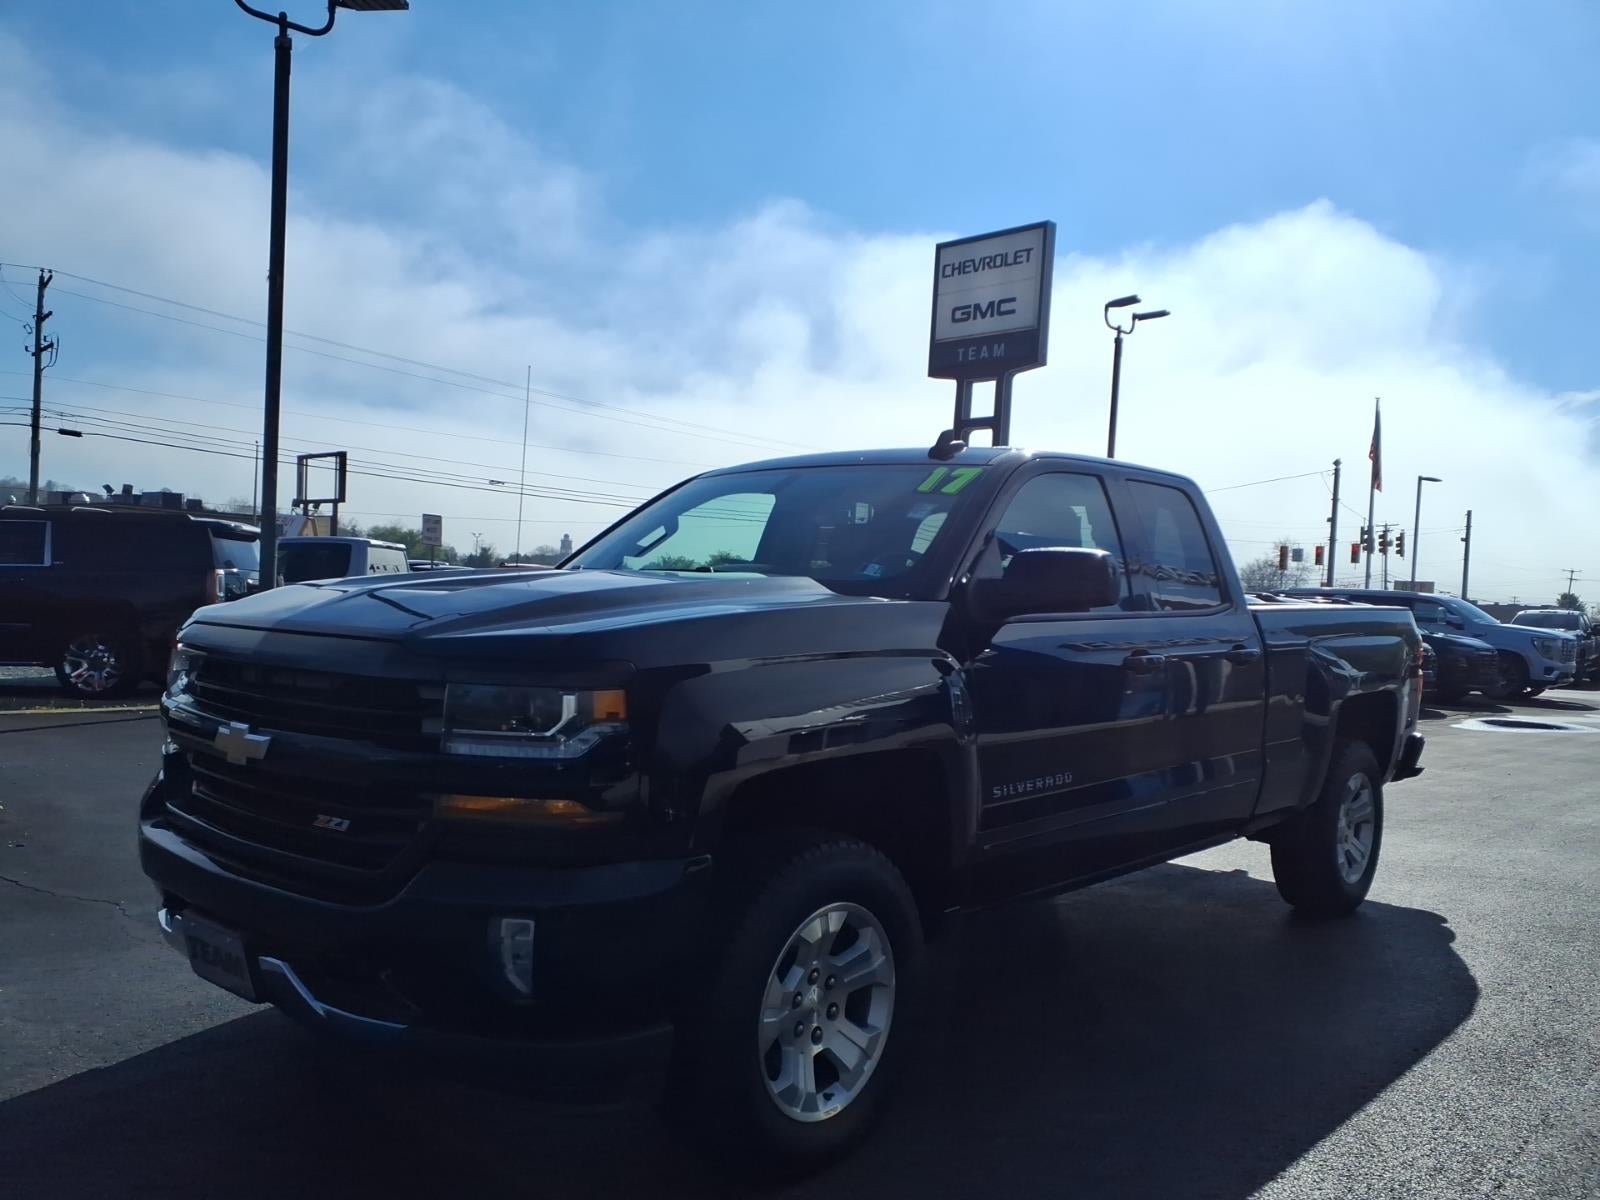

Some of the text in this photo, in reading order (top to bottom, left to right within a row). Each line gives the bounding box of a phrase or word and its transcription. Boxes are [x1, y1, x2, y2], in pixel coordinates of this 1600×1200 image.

[942, 248, 1034, 279] CHEVROLET
[951, 297, 1017, 323] GMC
[957, 343, 1006, 362] TEAM
[917, 466, 984, 496] 17
[992, 771, 1073, 799] SILVERADO
[312, 813, 352, 832] Z71
